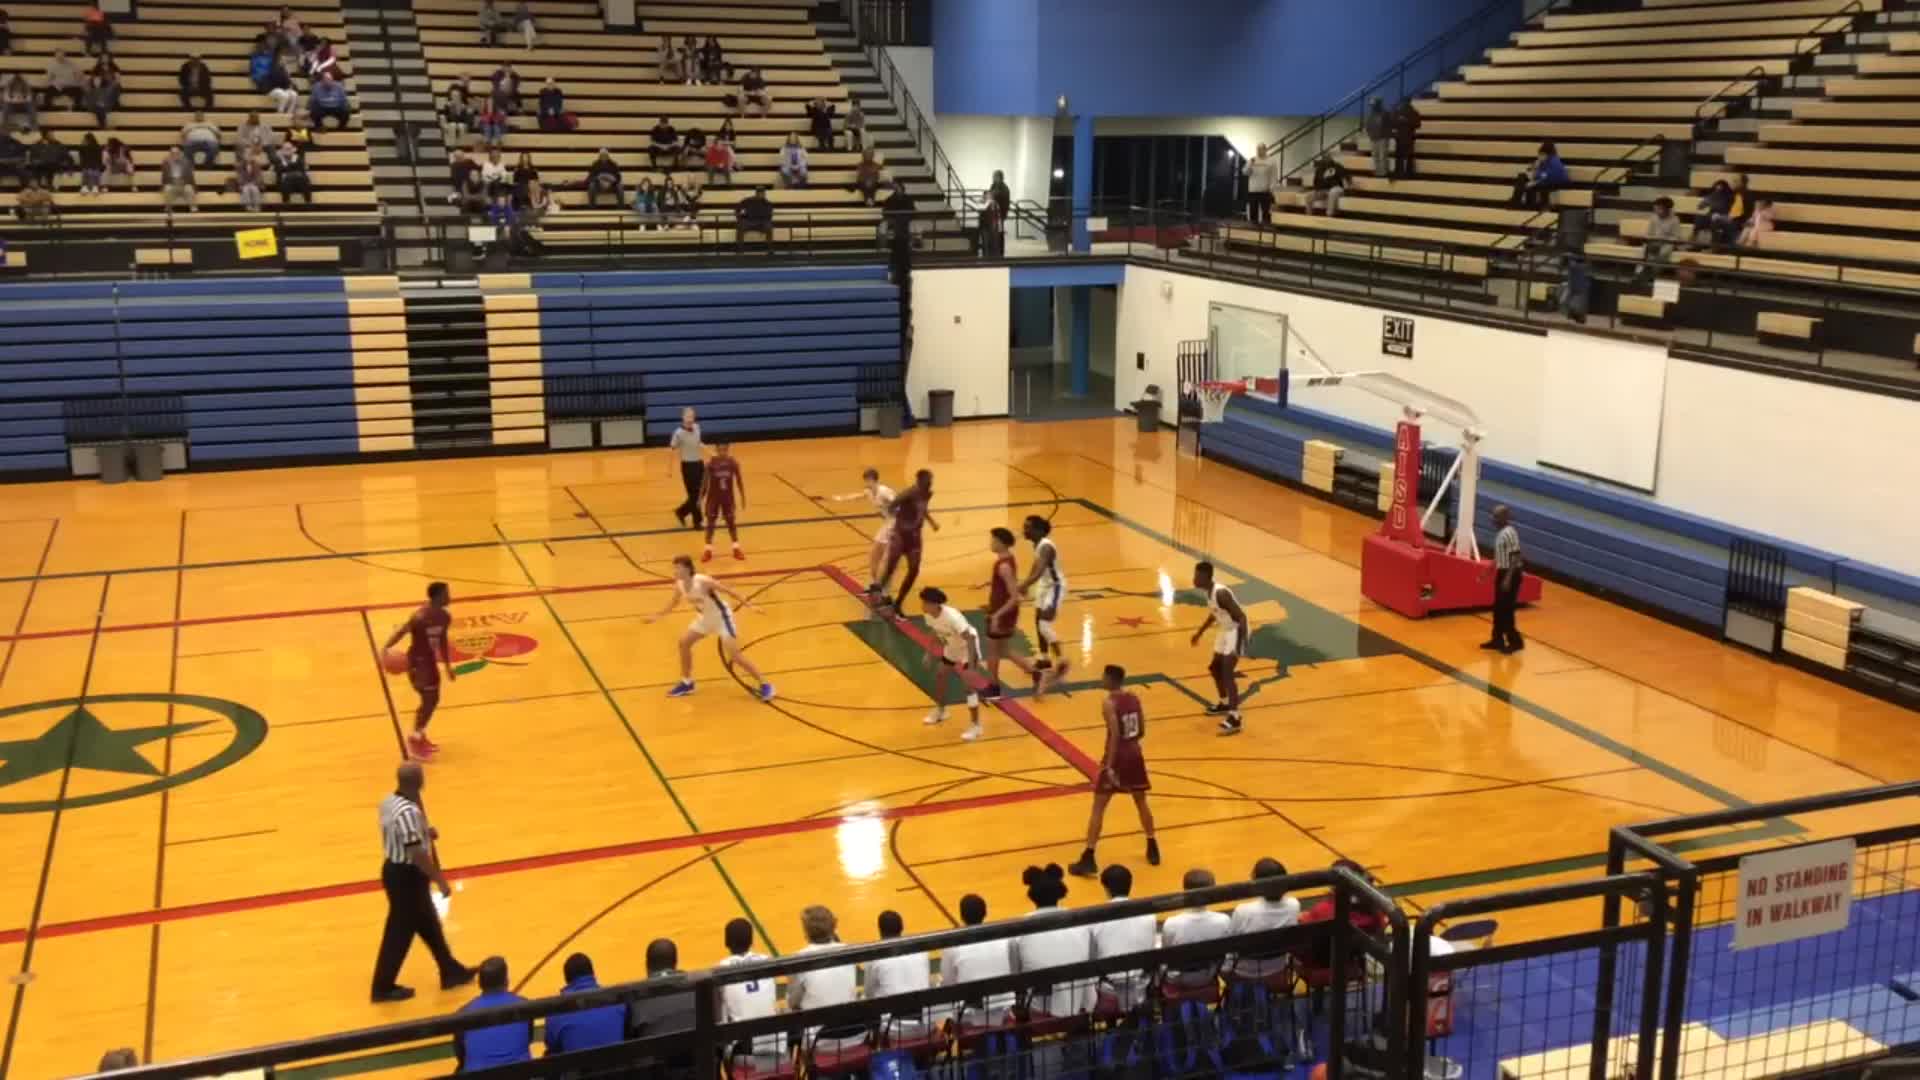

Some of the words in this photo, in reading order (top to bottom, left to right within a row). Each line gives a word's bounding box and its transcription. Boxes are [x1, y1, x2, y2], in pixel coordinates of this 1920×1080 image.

[1384, 317, 1413, 341] EXIT
[1746, 876, 1768, 897] NO
[1775, 861, 1848, 893] STANDING
[1745, 906, 1763, 928] IN
[1770, 893, 1842, 922] WALKWAY
